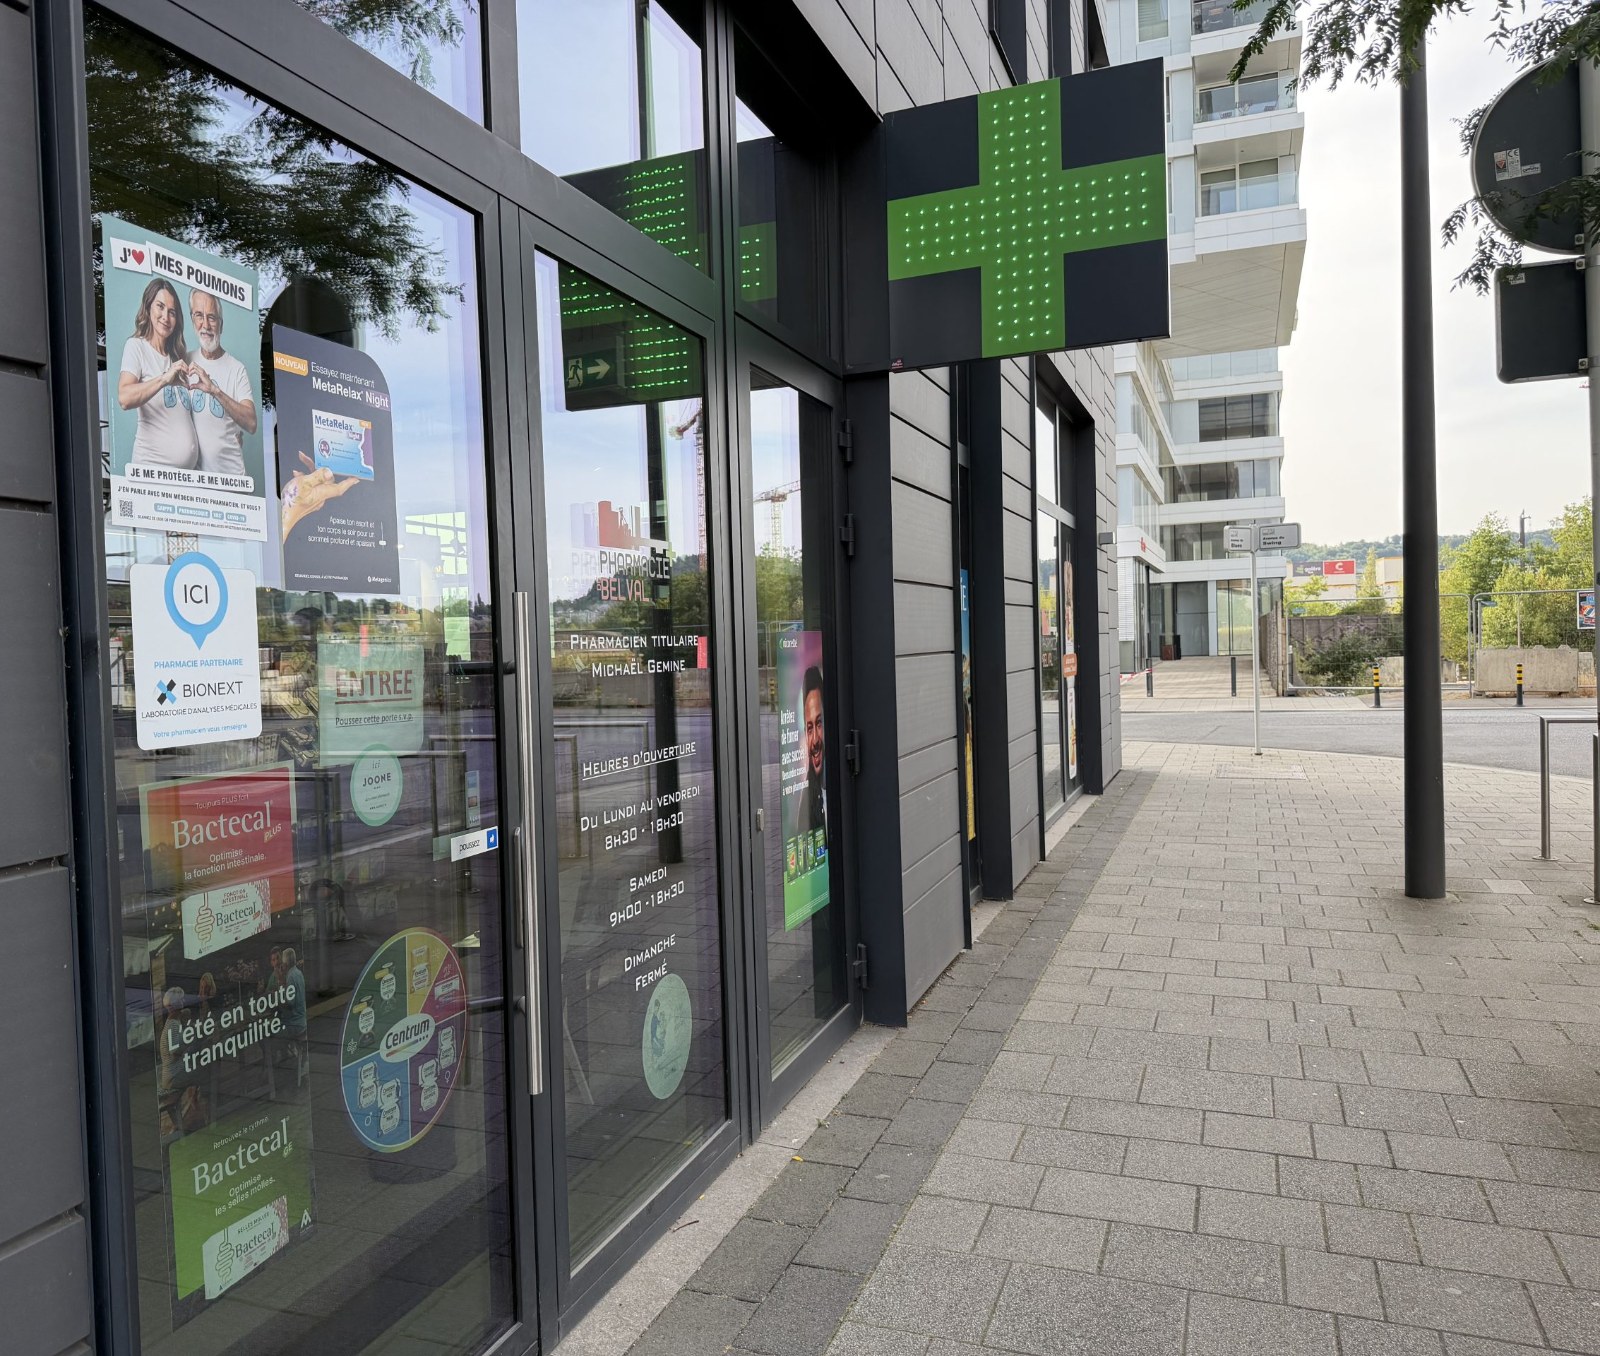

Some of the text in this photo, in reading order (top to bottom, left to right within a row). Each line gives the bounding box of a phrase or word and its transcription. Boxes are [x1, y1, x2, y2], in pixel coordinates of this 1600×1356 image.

[155, 252, 183, 277] MES
[187, 264, 245, 302] POUMONS
[275, 356, 306, 372] NOUVEAU
[311, 362, 375, 388] Essayez maintenant
[366, 391, 389, 408] Night
[130, 468, 253, 489] JE ME PROTÈGE. JE ME VACCINE.
[130, 488, 147, 496] PARLE
[600, 550, 671, 580] PHARMACIE
[183, 584, 209, 604] ICI
[601, 577, 650, 603] BELVAL
[570, 634, 699, 650] PHARMACIEN TITULAIRE
[154, 658, 244, 669] PHARMACIE PARTENAIRE
[592, 658, 686, 678] MICHAËL GEMINE
[183, 681, 243, 698] BIONEXT
[336, 669, 413, 698] ENTREE
[141, 708, 187, 719] LABORATOIRE
[187, 705, 224, 715] D'ANALYSES
[335, 712, 414, 726] Poussez cette porte s.v.p.
[780, 709, 795, 726] Arrêtez
[153, 730, 170, 739] Votre
[171, 727, 206, 739] pharmacien
[221, 723, 248, 733] renseigne
[781, 732, 787, 746] de
[583, 756, 629, 778] HEURES
[781, 751, 792, 766] avec
[362, 772, 392, 788] JOONE
[195, 793, 250, 810] Toujours PLUS fort
[580, 785, 700, 832] DU LUNDI AU VENDREDI
[264, 823, 282, 843] PLUS
[459, 838, 480, 854] poussez
[209, 848, 243, 865] Optimise
[184, 871, 192, 881] la
[193, 859, 226, 878] fonction
[629, 866, 667, 892] SAMEDI
[215, 901, 257, 927] Bactecal
[624, 933, 676, 973] DIMANCHE
[635, 958, 668, 992] FERMÉ
[167, 984, 296, 1052] L'été en toute
[182, 1011, 286, 1073] tranquilité.
[385, 1018, 430, 1050] Centrum
[213, 1131, 242, 1150] Retrouvez
[283, 1141, 293, 1158] GE
[228, 1173, 262, 1197] Optimise
[215, 1178, 276, 1217] les selles molles.
[235, 1222, 275, 1259] Bactecal
